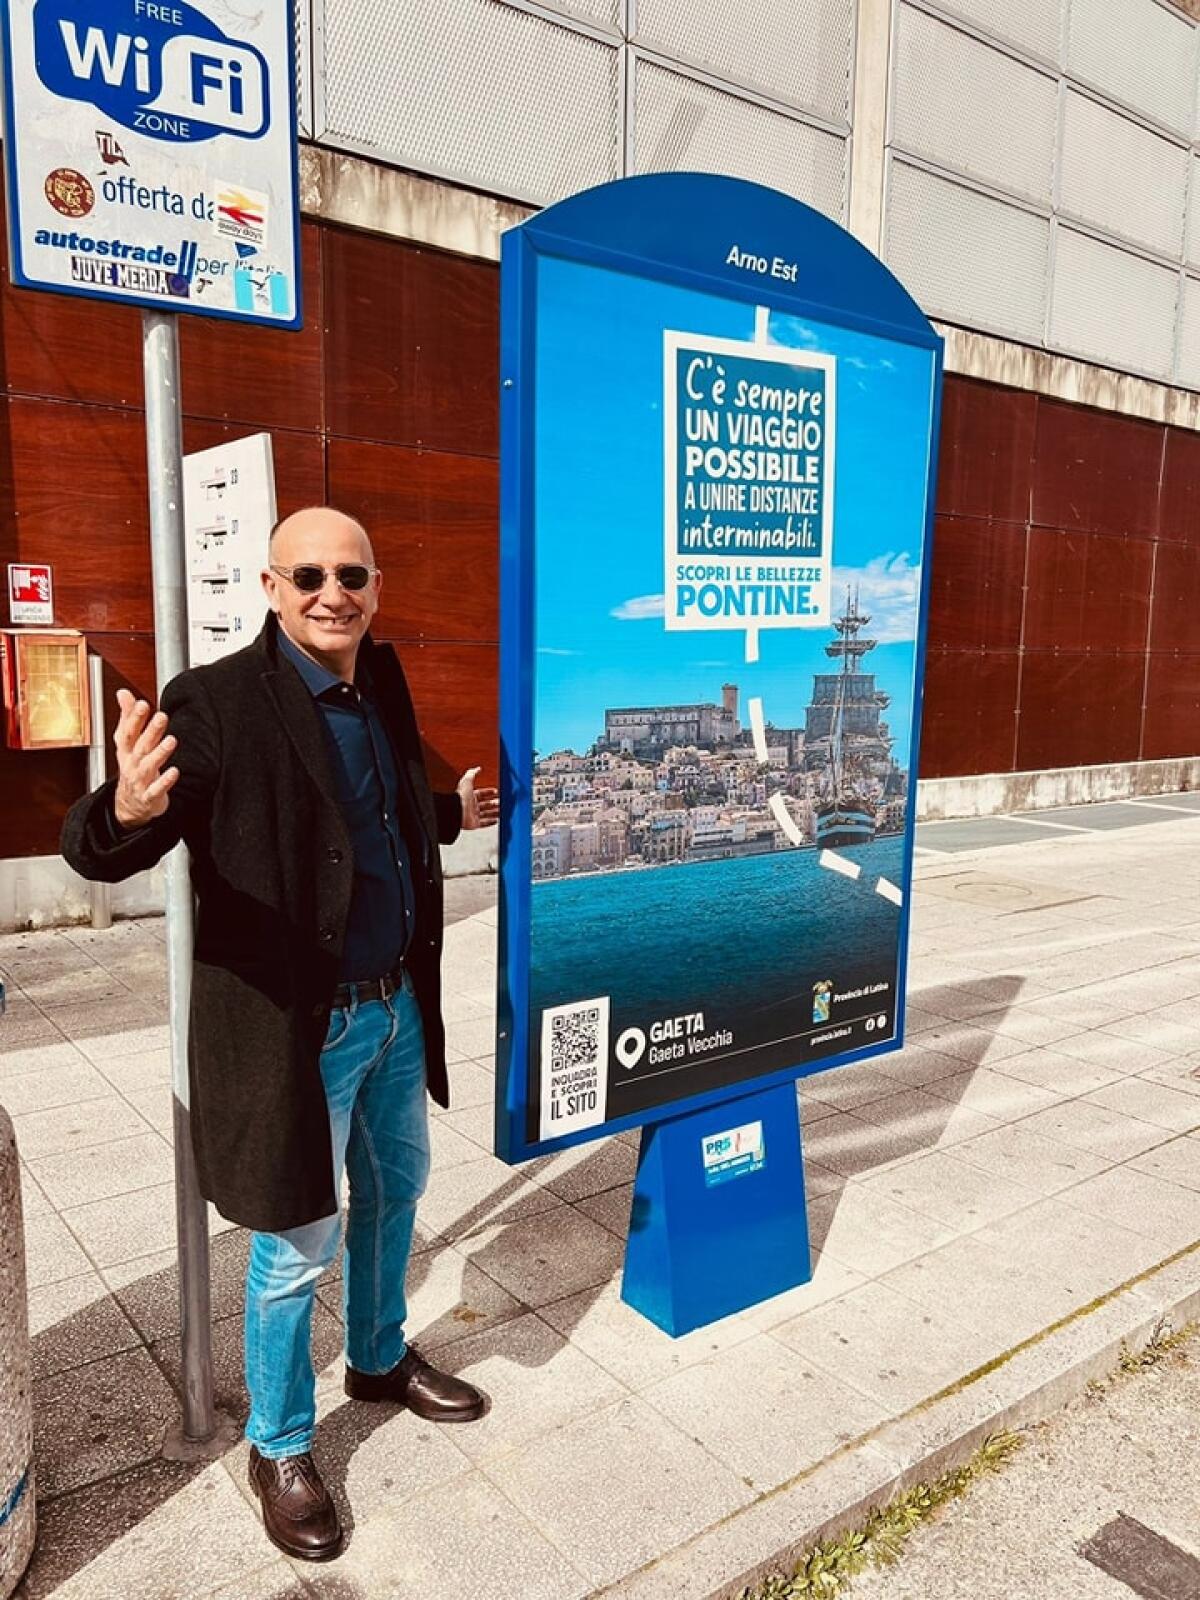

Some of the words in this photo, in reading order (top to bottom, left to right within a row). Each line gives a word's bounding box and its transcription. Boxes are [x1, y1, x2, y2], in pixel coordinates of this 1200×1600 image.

[134, 0, 183, 26] FREE
[133, 111, 190, 138] ZONE
[103, 176, 184, 216] offerta
[35, 229, 177, 266] autostrade
[195, 256, 228, 275] per
[726, 245, 768, 274] Arno
[771, 256, 798, 282] Est
[118, 263, 169, 294] MERDA
[686, 356, 726, 405] C'è
[734, 379, 821, 420] sempre
[686, 408, 719, 442] UN
[727, 412, 821, 451] VIAGGIO
[685, 446, 819, 483] POSSIBILE
[684, 482, 695, 510] A
[700, 483, 746, 513] UNIRE
[752, 486, 819, 515] DISTANZE
[683, 514, 816, 550] interminabili.
[676, 565, 731, 581] SCOPRI
[736, 566, 752, 581] LE
[757, 567, 821, 582] BELLEZZE
[676, 584, 819, 617] PONTINE.
[650, 1012, 705, 1043] GAETA
[649, 1042, 685, 1065] Gaeta
[688, 1029, 733, 1055] Vecchia
[551, 1089, 557, 1099] E
[561, 1077, 597, 1097] SCOPRI
[551, 1100, 563, 1121] IL
[567, 1090, 597, 1116] SITO
